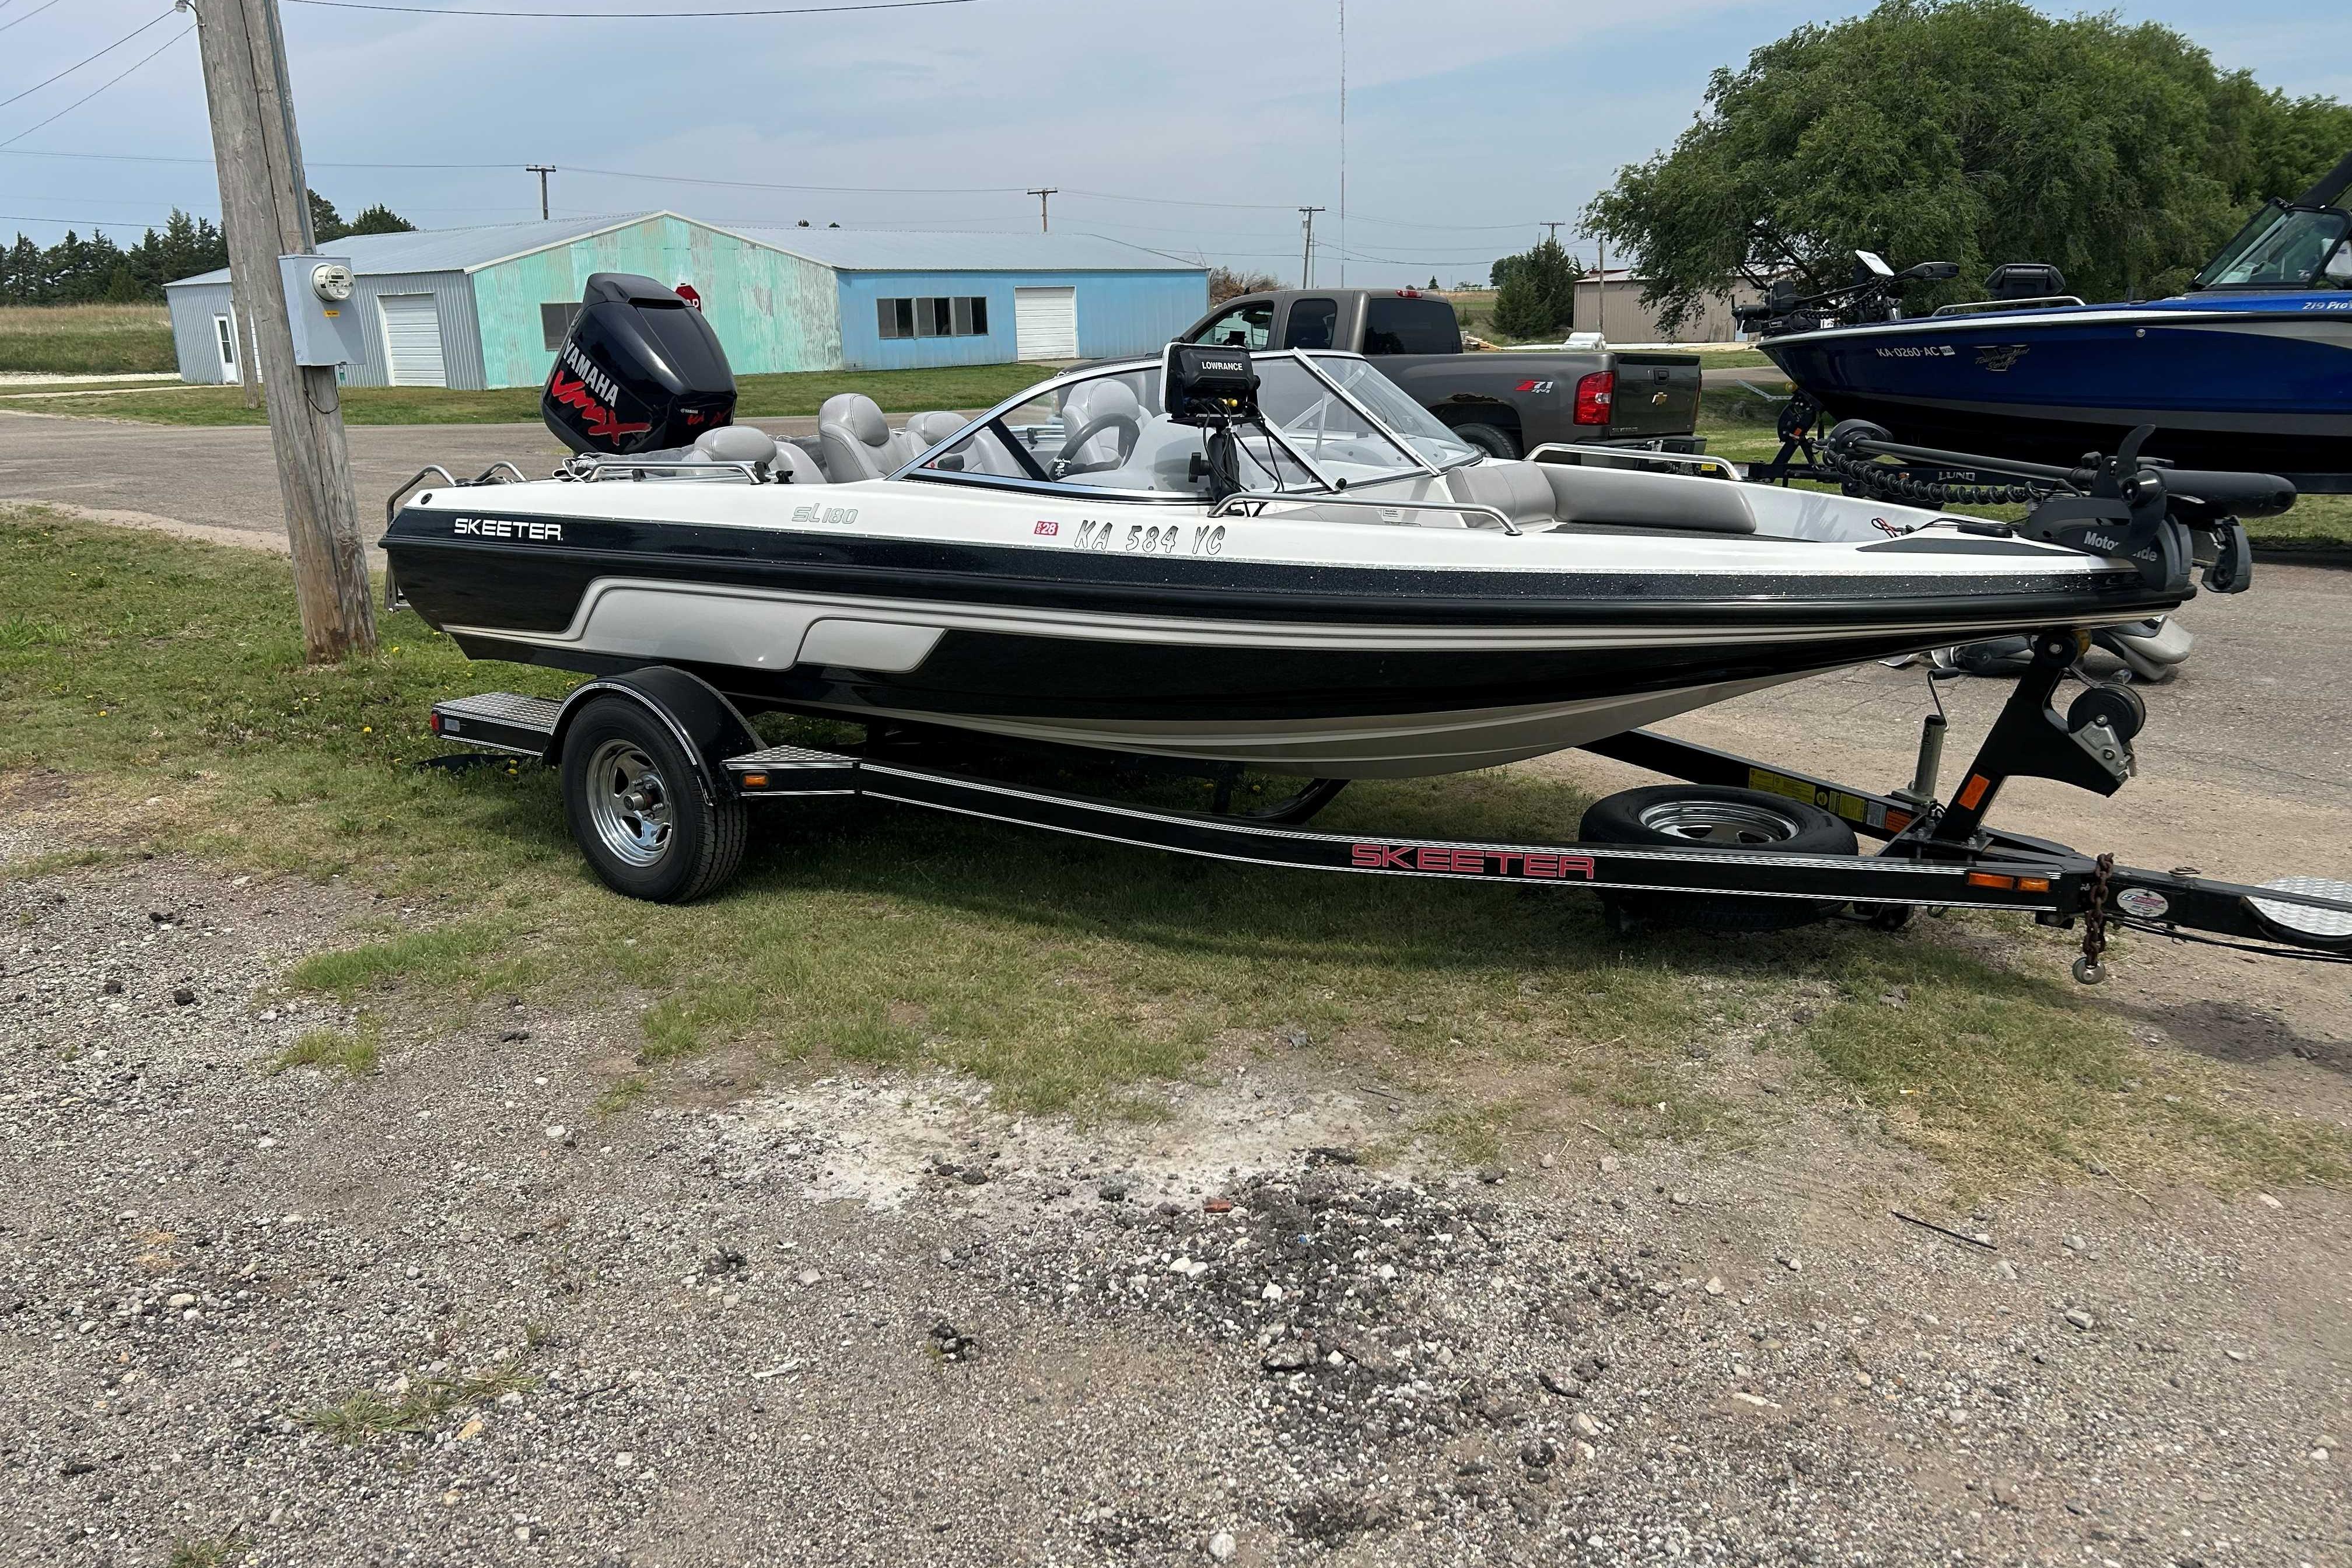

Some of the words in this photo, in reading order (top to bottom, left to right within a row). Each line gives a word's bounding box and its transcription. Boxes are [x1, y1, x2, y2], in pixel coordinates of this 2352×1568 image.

[2301, 302, 2325, 310] 219
[1202, 361, 1243, 371] LOWRANCE
[563, 337, 619, 408] YAMAHA
[1515, 380, 1553, 391] Z71
[1938, 471, 1975, 481] LUND
[454, 518, 562, 541] SKEETER
[1041, 523, 1056, 534] 28
[1074, 520, 1112, 550] KA
[1126, 525, 1178, 553] 584
[1192, 524, 1225, 555] YC
[1352, 844, 1594, 879] SKEETER
